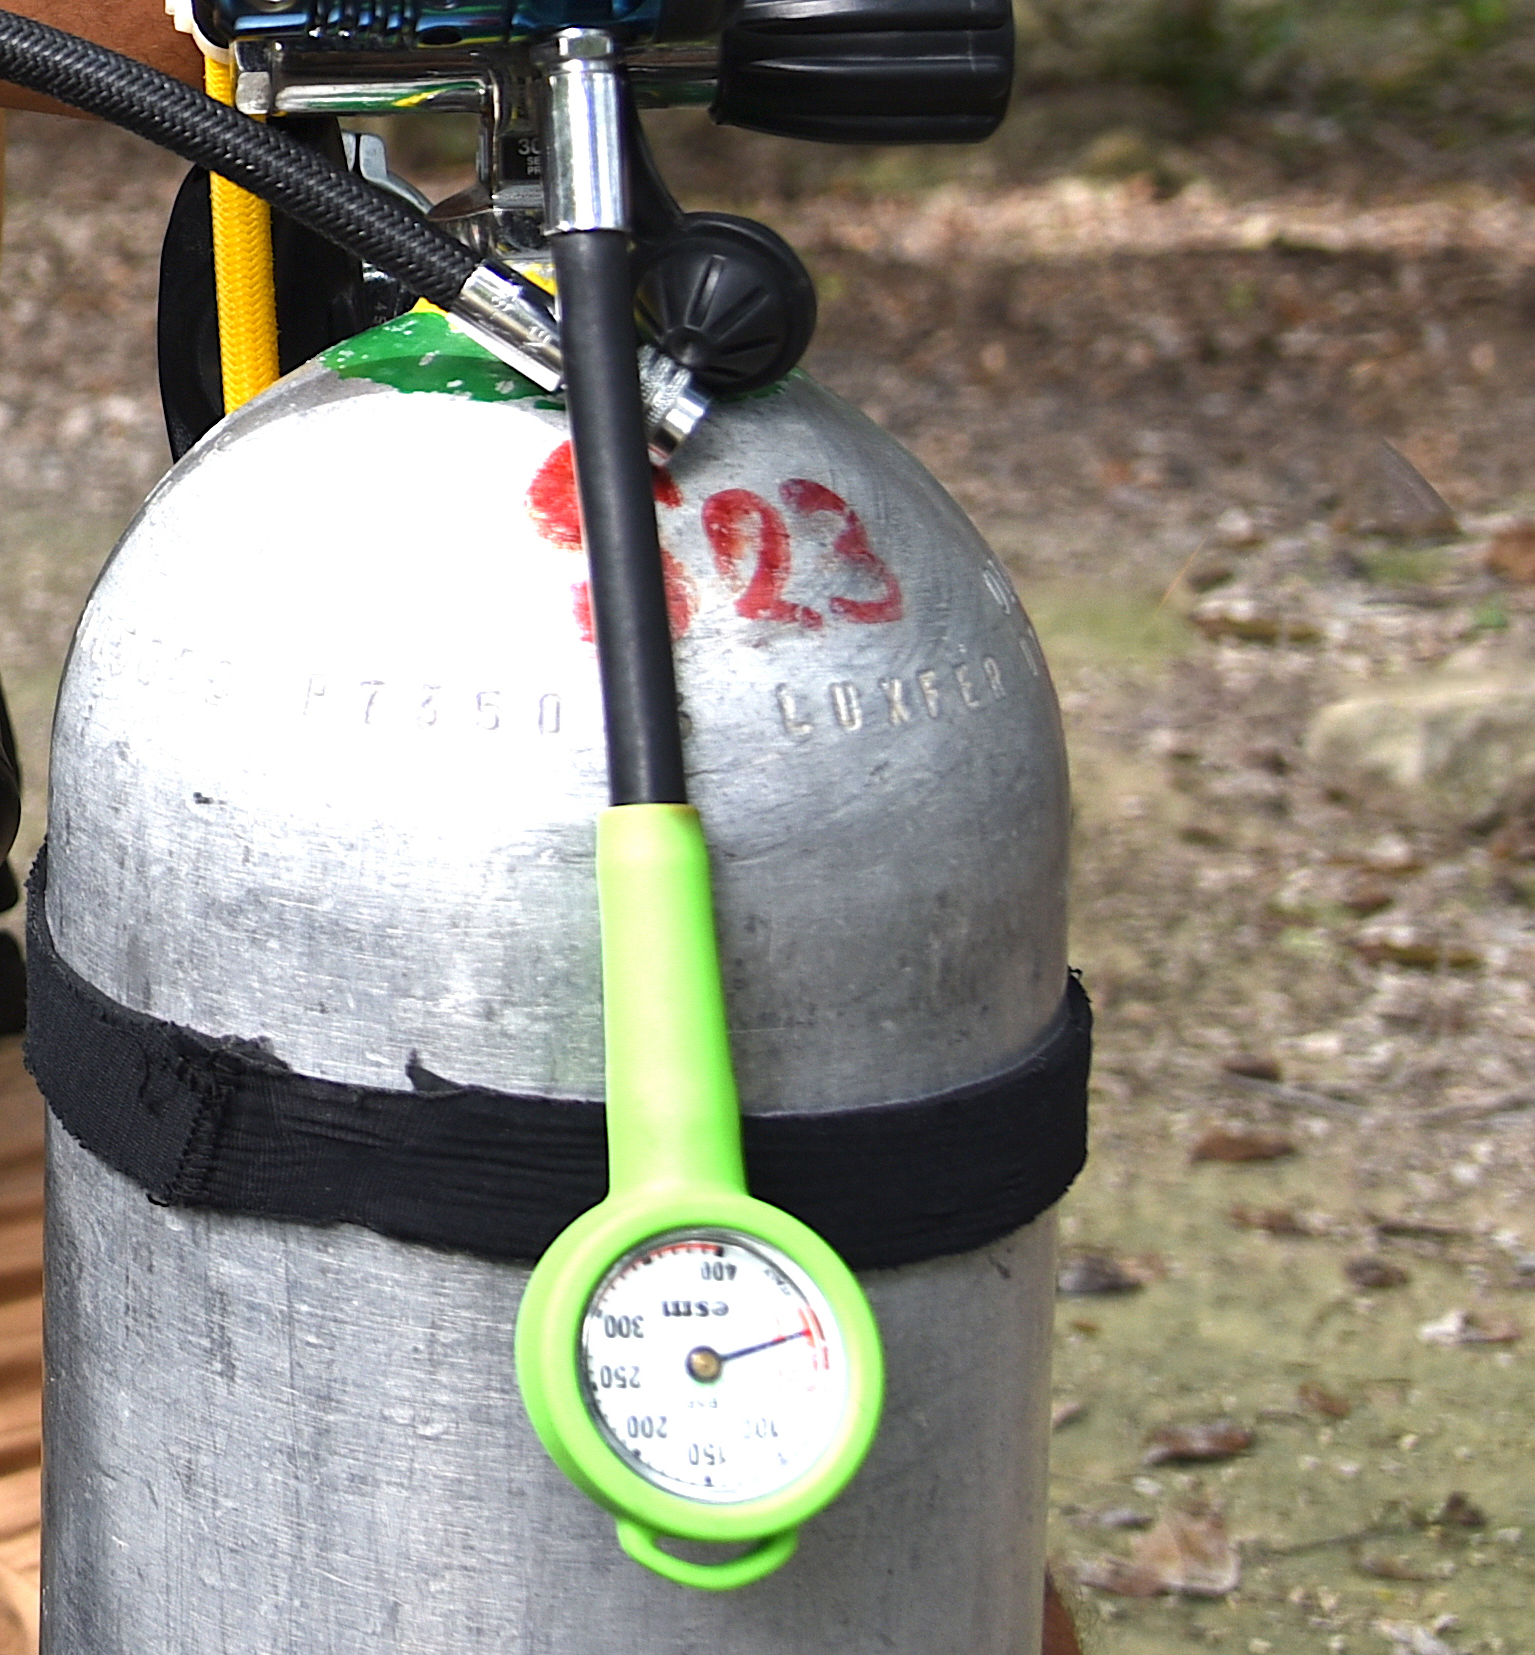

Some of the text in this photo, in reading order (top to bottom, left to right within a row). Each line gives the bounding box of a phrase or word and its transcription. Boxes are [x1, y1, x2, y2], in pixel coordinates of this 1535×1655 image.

[775, 654, 1008, 735] LUXFER
[700, 1261, 738, 1281] 400
[661, 1299, 730, 1318] esm
[603, 1314, 645, 1339] 300
[599, 1366, 642, 1390] 250
[627, 1415, 669, 1440] 200
[688, 1443, 728, 1466] 150
